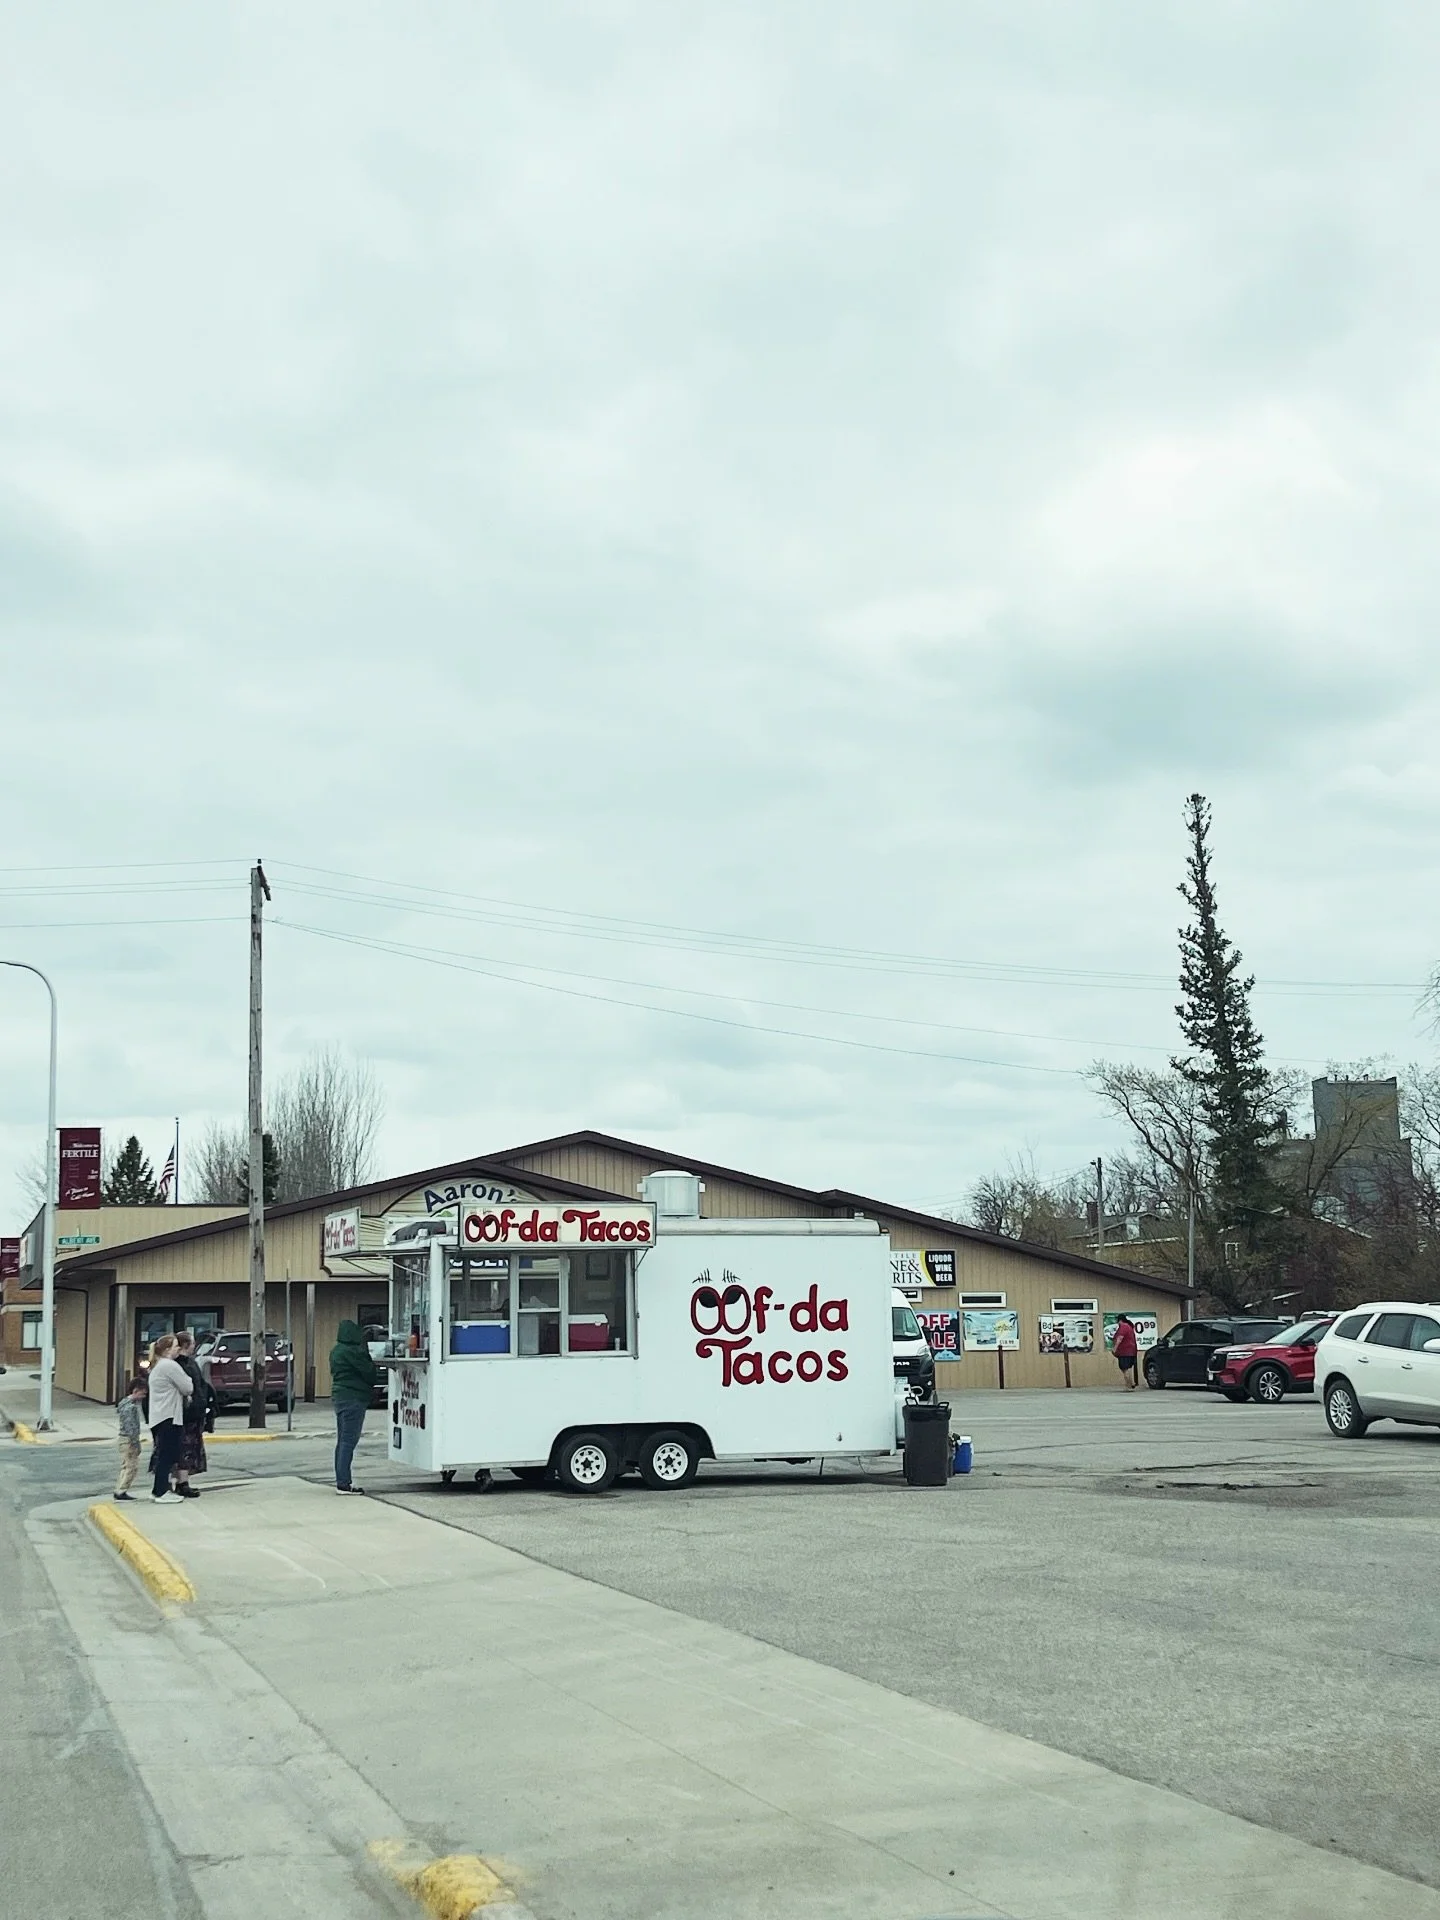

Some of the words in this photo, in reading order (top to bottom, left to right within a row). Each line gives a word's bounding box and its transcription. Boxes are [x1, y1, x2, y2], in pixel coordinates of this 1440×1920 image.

[62, 1149, 99, 1158] FERTILE
[424, 1184, 517, 1213] Aaron'
[562, 1209, 651, 1242] Tacos
[928, 1254, 953, 1263] LIQUOR
[935, 1264, 953, 1272] WINE
[893, 1272, 922, 1284] RITS
[935, 1273, 953, 1282] BEER
[695, 1335, 849, 1387] Tacos
